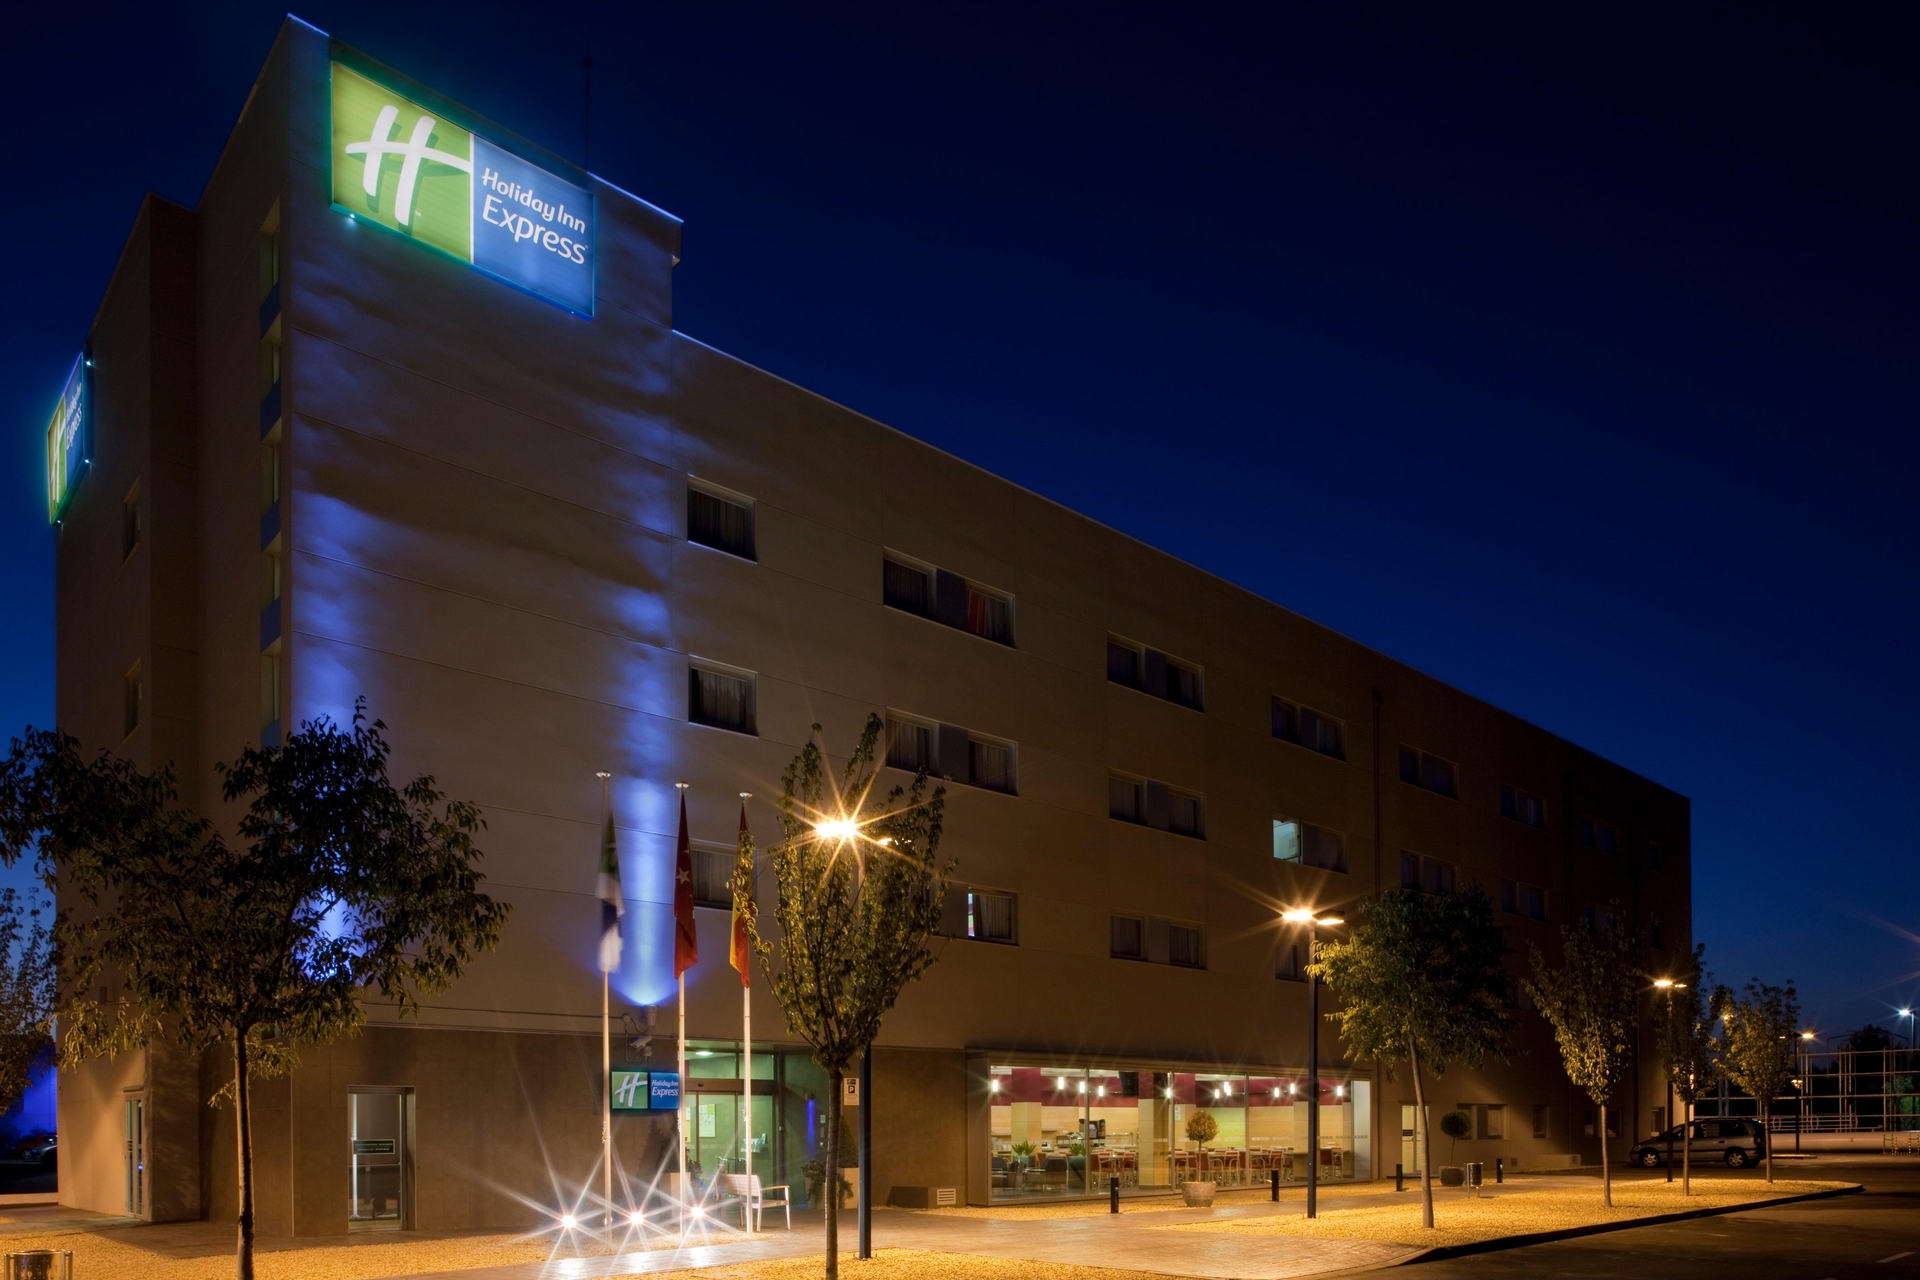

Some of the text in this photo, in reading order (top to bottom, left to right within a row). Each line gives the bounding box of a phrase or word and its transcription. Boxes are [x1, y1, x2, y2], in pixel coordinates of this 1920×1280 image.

[482, 167, 586, 234] Holiday Inn
[482, 194, 585, 265] Express
[652, 1087, 678, 1097] Express
